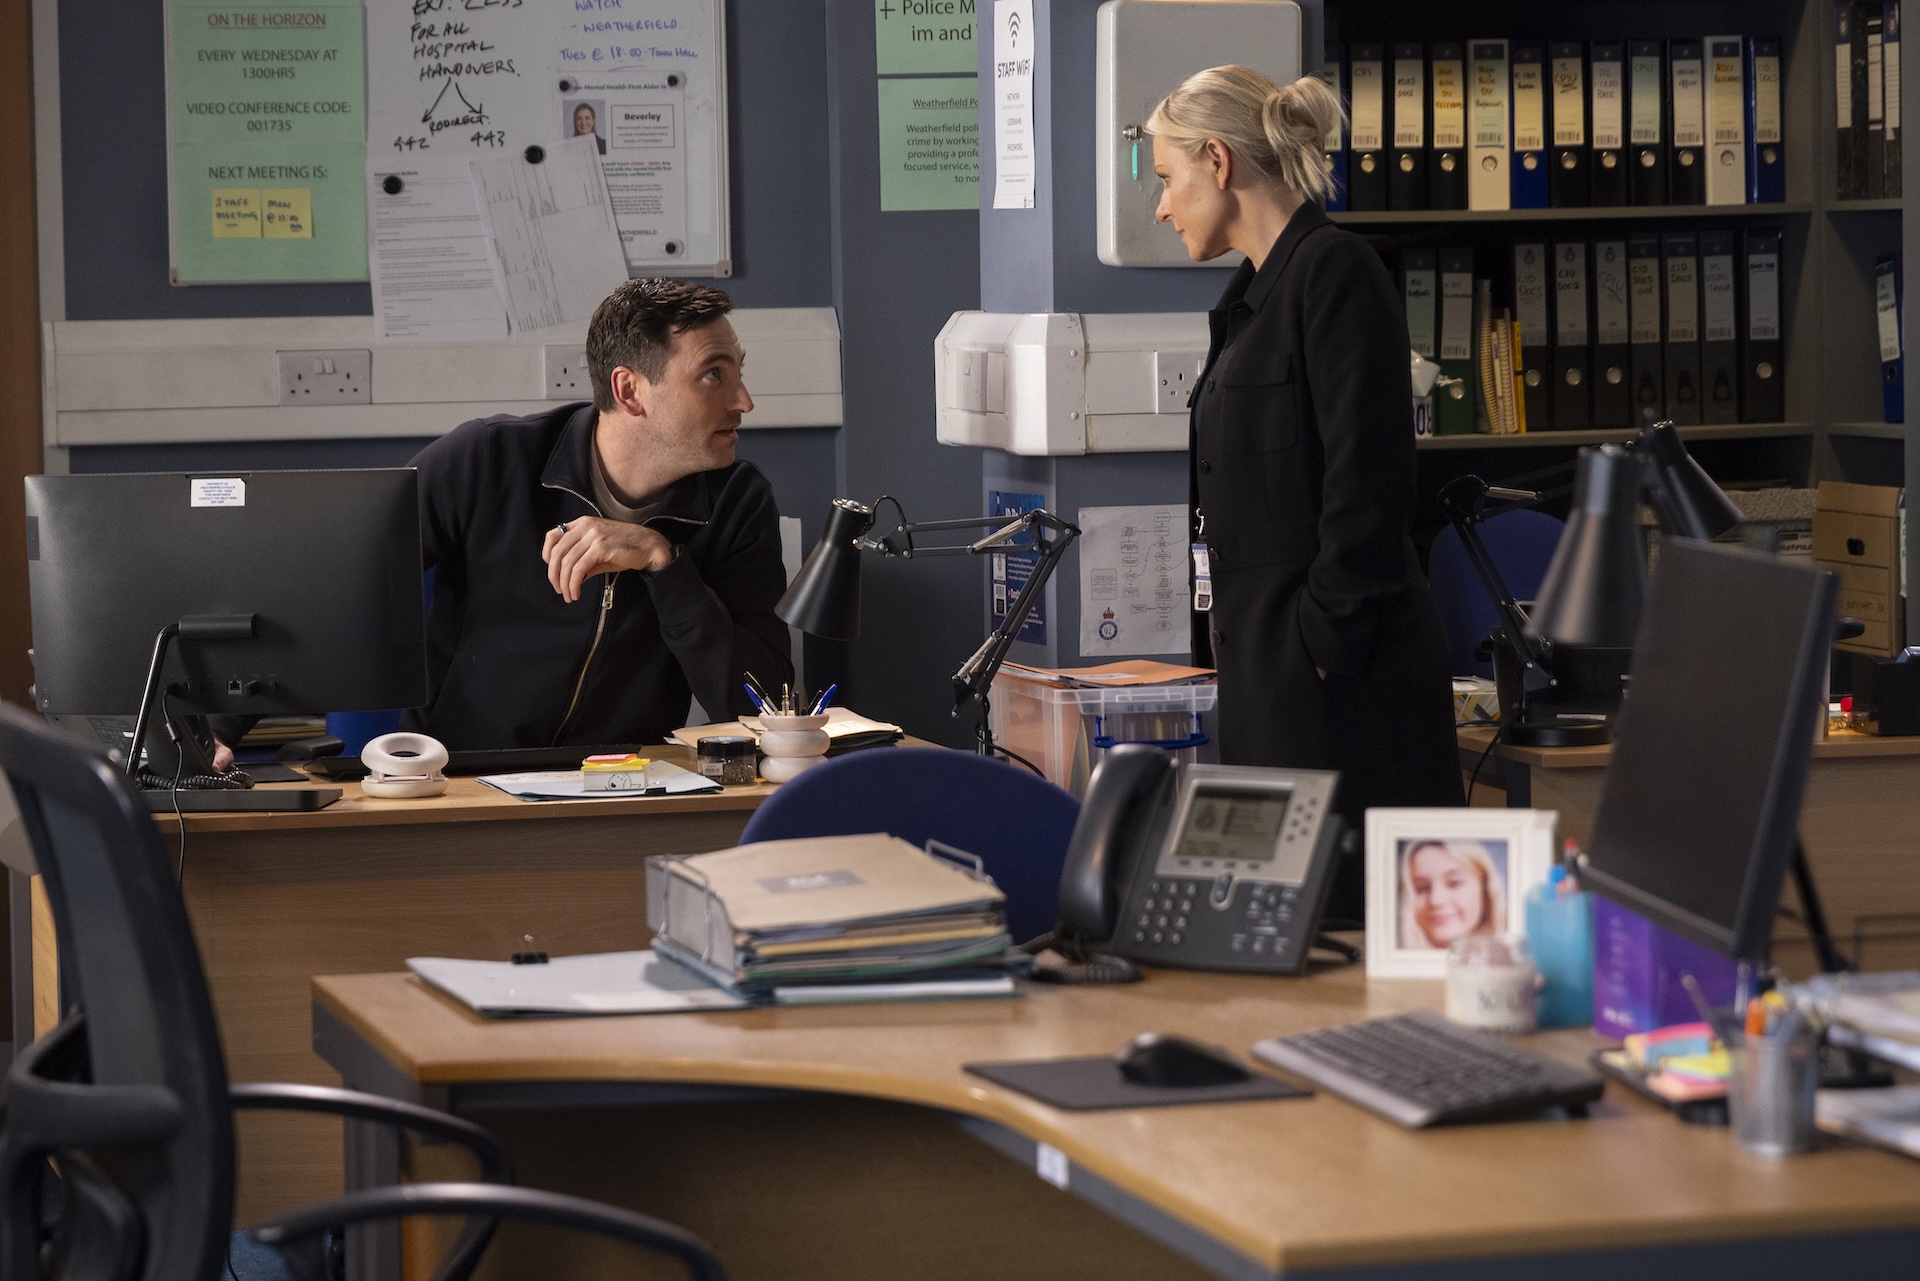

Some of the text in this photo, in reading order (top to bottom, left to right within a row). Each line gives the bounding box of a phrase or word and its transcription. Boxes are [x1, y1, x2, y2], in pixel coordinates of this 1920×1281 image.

[903, 0, 954, 15] Police
[207, 13, 326, 26] ON THE HORIZON
[583, 18, 677, 33] WEATHERFIELD
[411, 22, 469, 42] FOR ALL
[939, 23, 972, 41] and
[198, 49, 338, 62] EVERY WEDNESDAY AT
[592, 49, 603, 61] @
[242, 67, 296, 79] 1300HRS
[998, 61, 1015, 78] STAFF
[187, 101, 351, 114] VIDEO CONFERENCE CODE:
[912, 98, 968, 108] Weatherfield
[624, 113, 661, 122] Beverley
[246, 120, 292, 132] 001735
[906, 123, 961, 133] Weatherfield
[393, 135, 430, 152] 442
[470, 131, 505, 148] 443
[907, 137, 932, 146] crime
[933, 136, 944, 147] by
[908, 149, 949, 160] providing
[951, 150, 956, 158] a
[208, 165, 328, 179] NEXT MEETING IS:
[903, 162, 938, 171] focused
[939, 162, 971, 171] service,
[955, 175, 964, 183] to
[216, 198, 249, 208] STAFF
